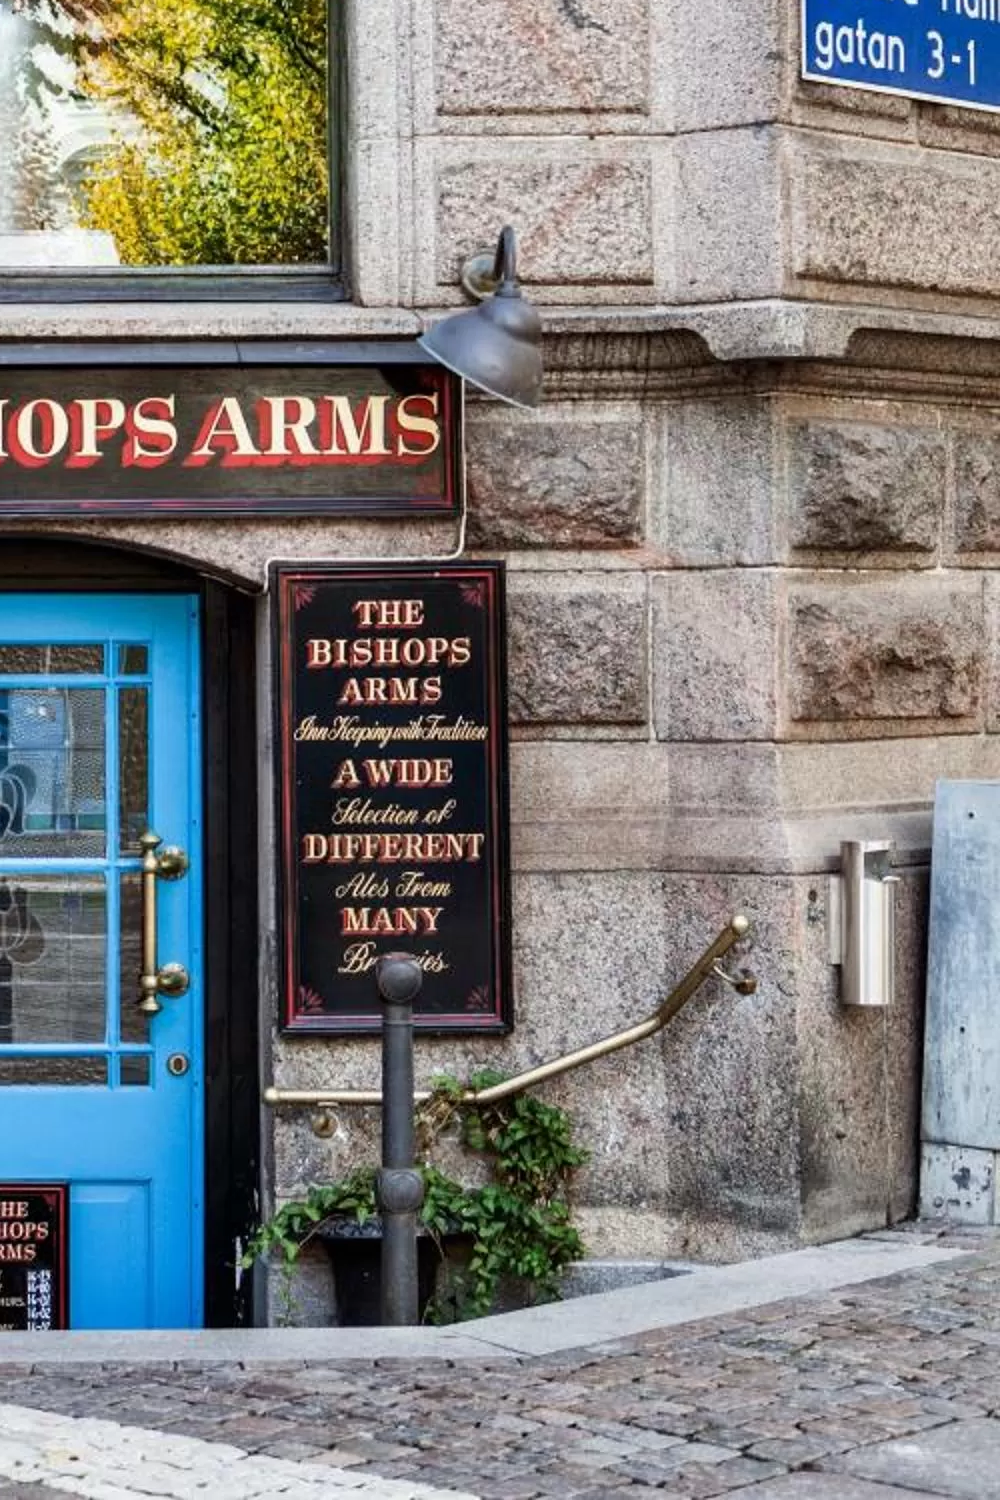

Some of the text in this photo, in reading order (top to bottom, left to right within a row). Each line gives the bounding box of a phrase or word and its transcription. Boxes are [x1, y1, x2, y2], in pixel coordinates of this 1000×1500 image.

[814, 18, 905, 73] gatan
[190, 391, 441, 457] ARMS
[353, 599, 425, 627] THE
[306, 636, 472, 667] BISHOPS
[338, 675, 443, 704] ARMS
[293, 714, 327, 741] Inn
[391, 714, 424, 741] with
[421, 714, 489, 741] Tradition
[334, 758, 454, 786] A WIDE
[331, 797, 457, 825] Selection of
[303, 833, 485, 861] DIFFERENT
[335, 871, 451, 898] Ales From
[342, 907, 443, 933] MANY
